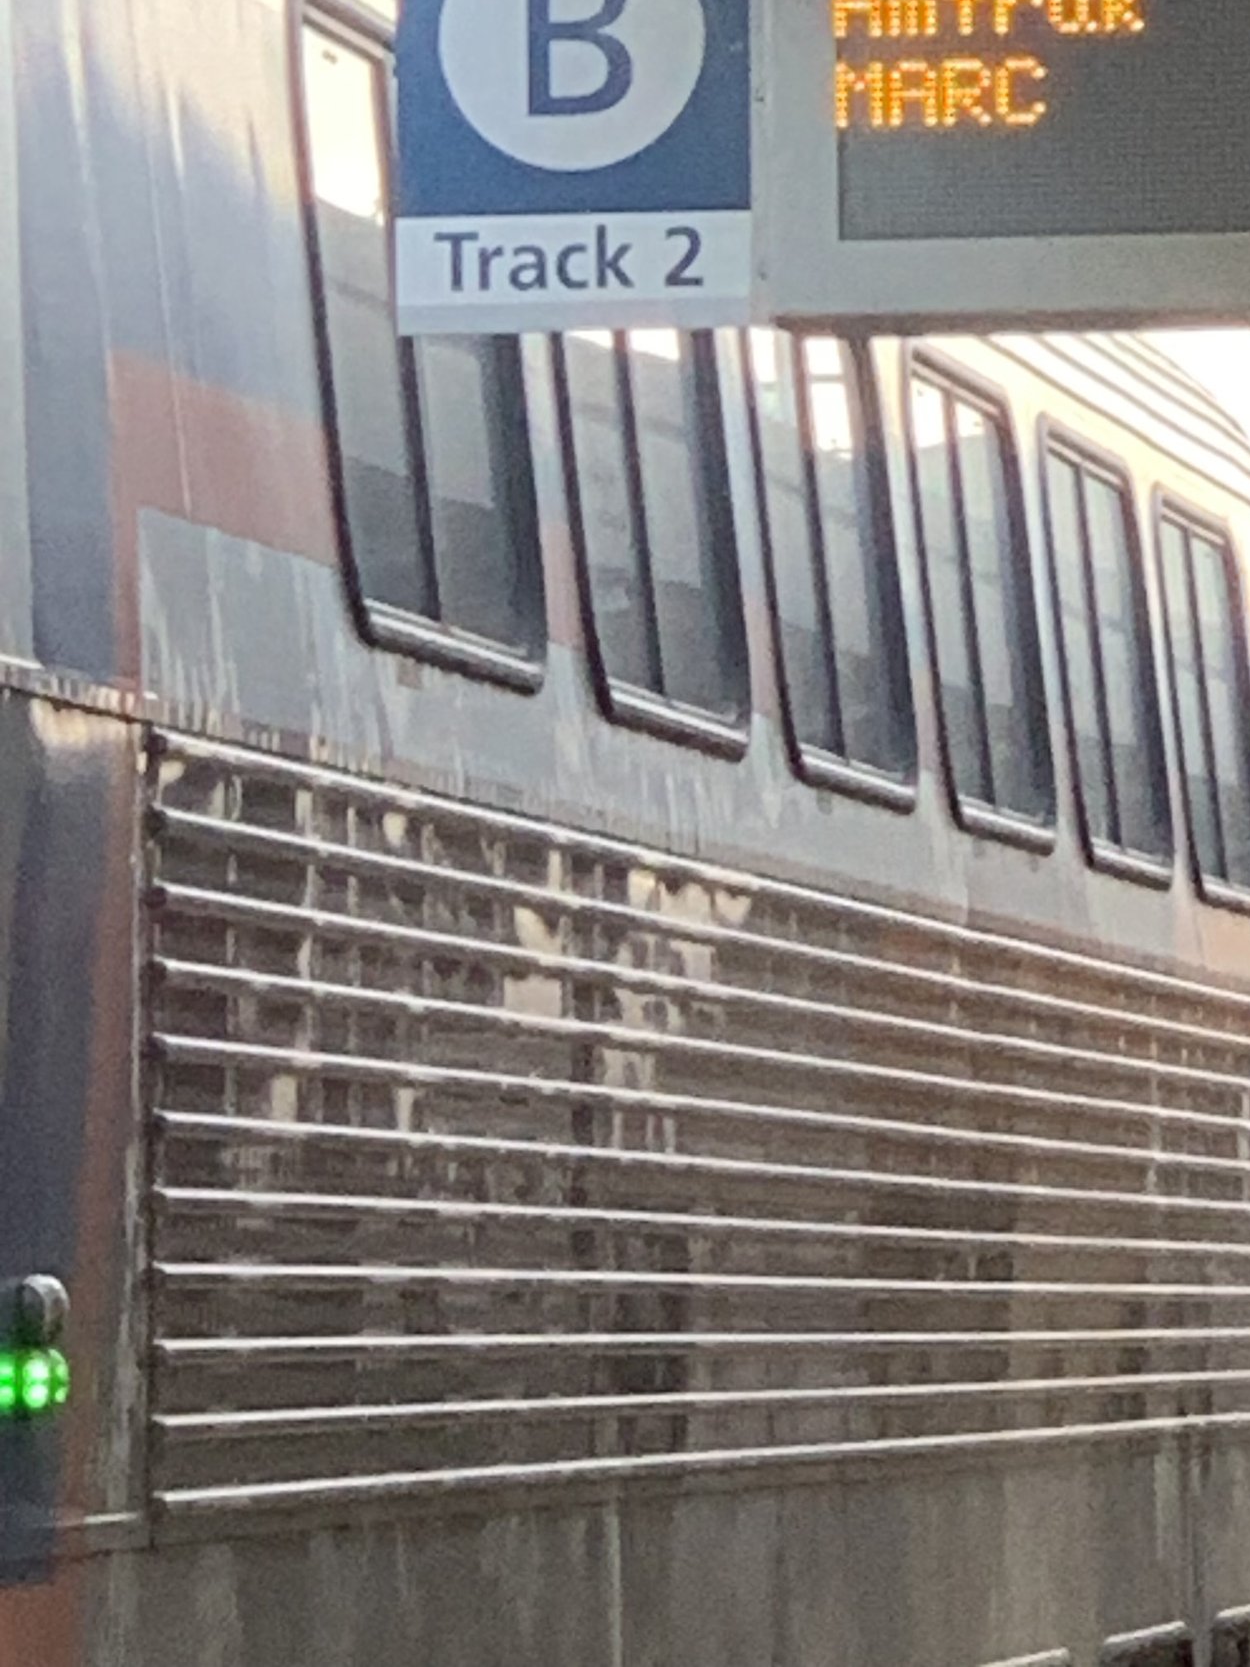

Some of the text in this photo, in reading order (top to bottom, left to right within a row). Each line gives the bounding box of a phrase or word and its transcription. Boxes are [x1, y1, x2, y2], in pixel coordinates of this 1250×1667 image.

[834, 55, 1048, 129] MARC
[434, 225, 704, 291] Track 2
